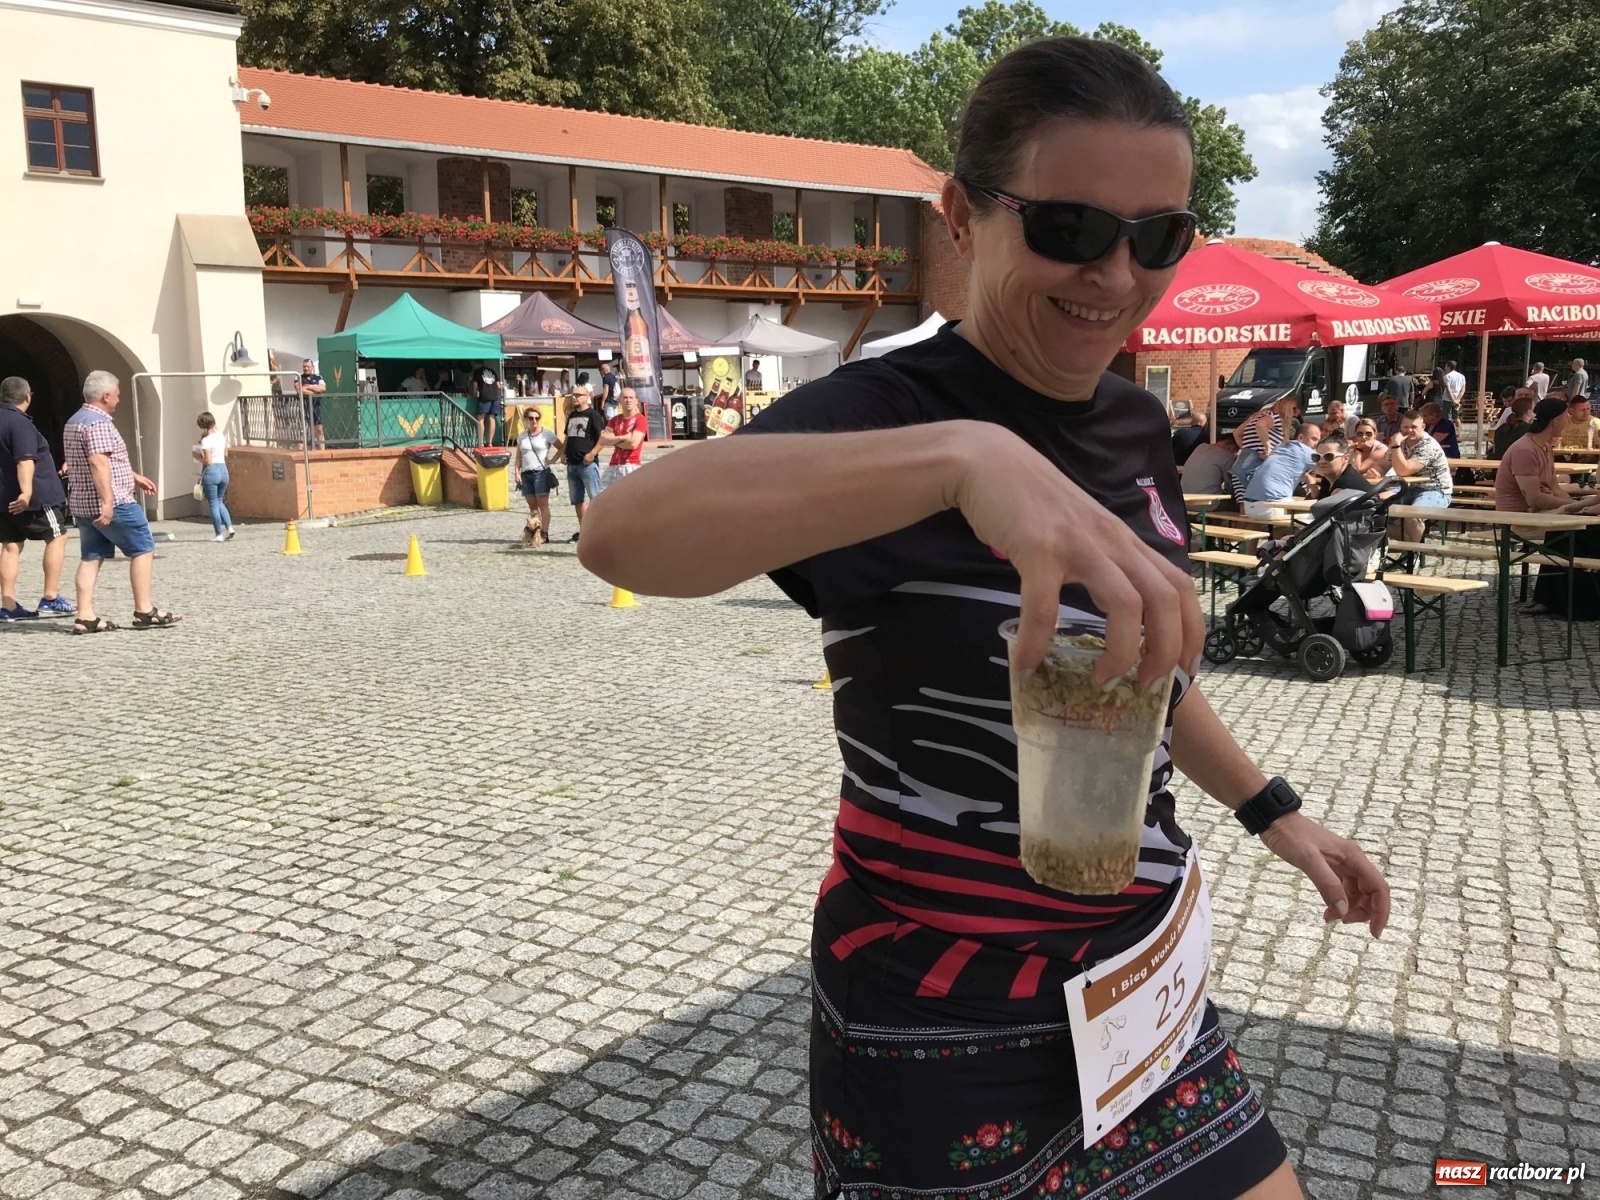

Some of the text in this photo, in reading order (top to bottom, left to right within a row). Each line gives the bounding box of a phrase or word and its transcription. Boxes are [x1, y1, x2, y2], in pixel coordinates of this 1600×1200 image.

[1441, 308, 1487, 326] SKIE
[1526, 304, 1600, 323] RACIBO
[1141, 323, 1291, 345] RACIBORSKIE
[1331, 314, 1431, 339] RACIBORSKIE
[1121, 966, 1149, 992] Bieg
[1155, 960, 1186, 1030] 25
